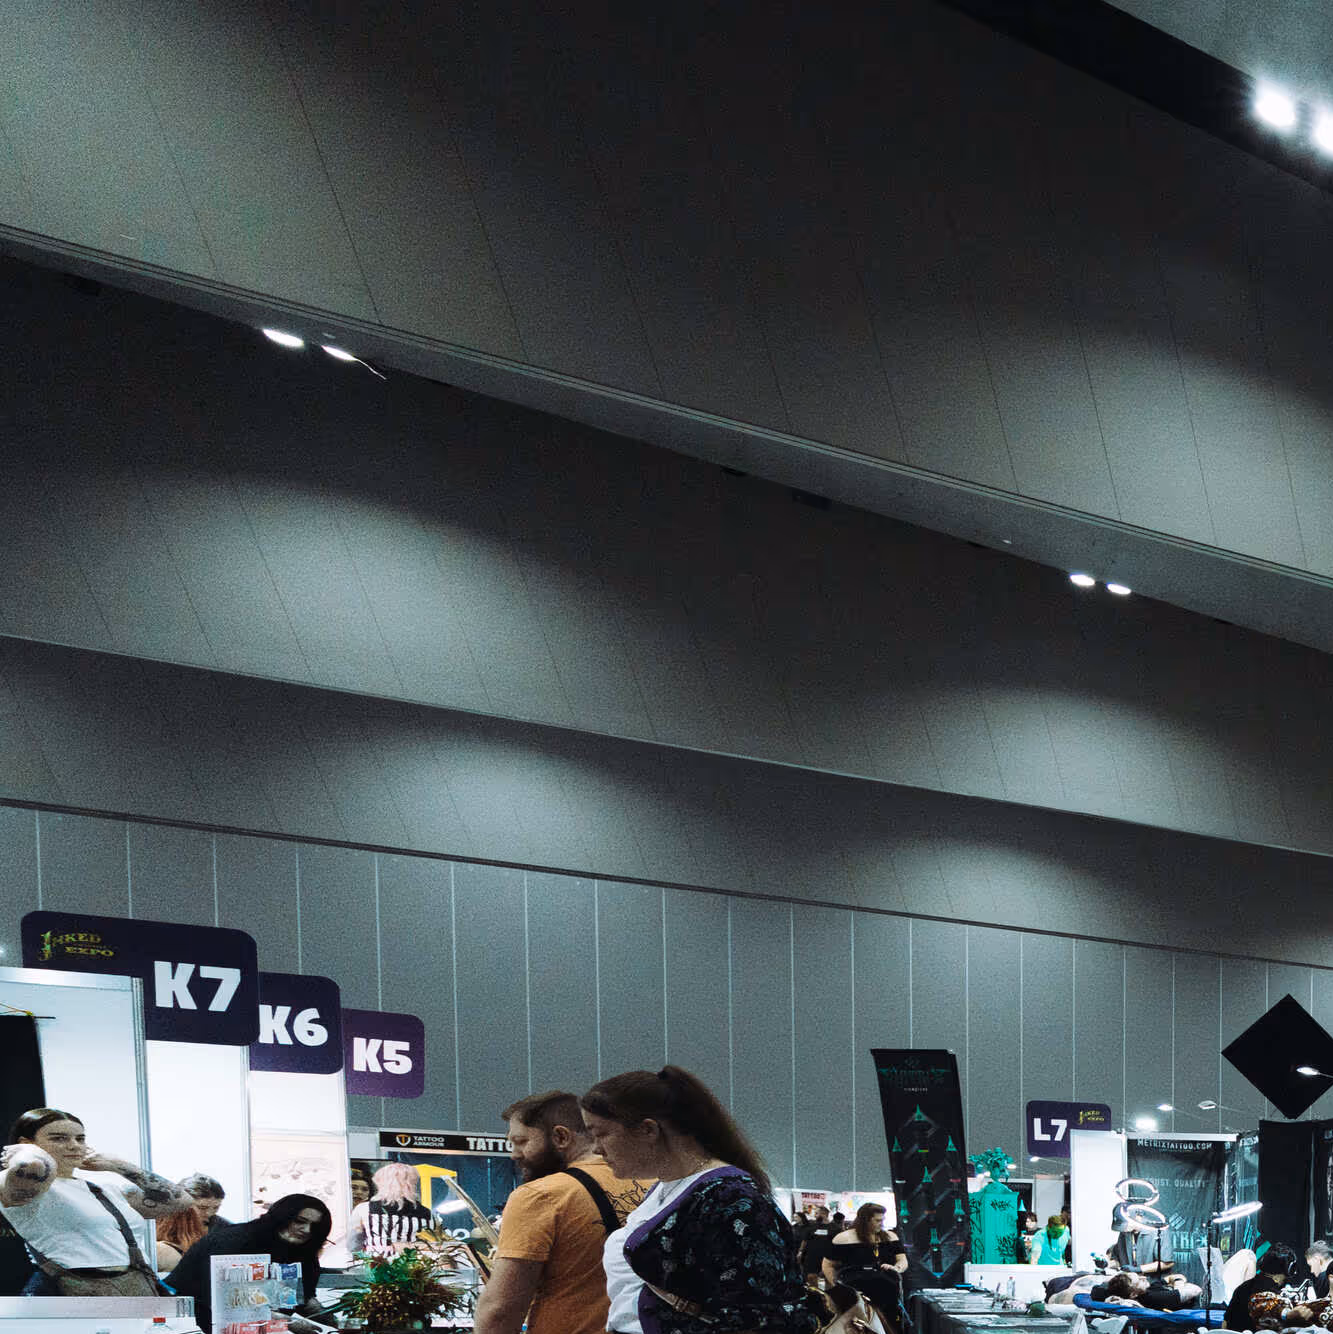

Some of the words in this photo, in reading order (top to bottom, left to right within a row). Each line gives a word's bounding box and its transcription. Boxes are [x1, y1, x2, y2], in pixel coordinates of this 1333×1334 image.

[153, 960, 242, 1012] K7
[258, 1004, 329, 1047] K6
[352, 1037, 413, 1075] K5
[1033, 1117, 1068, 1142] L7
